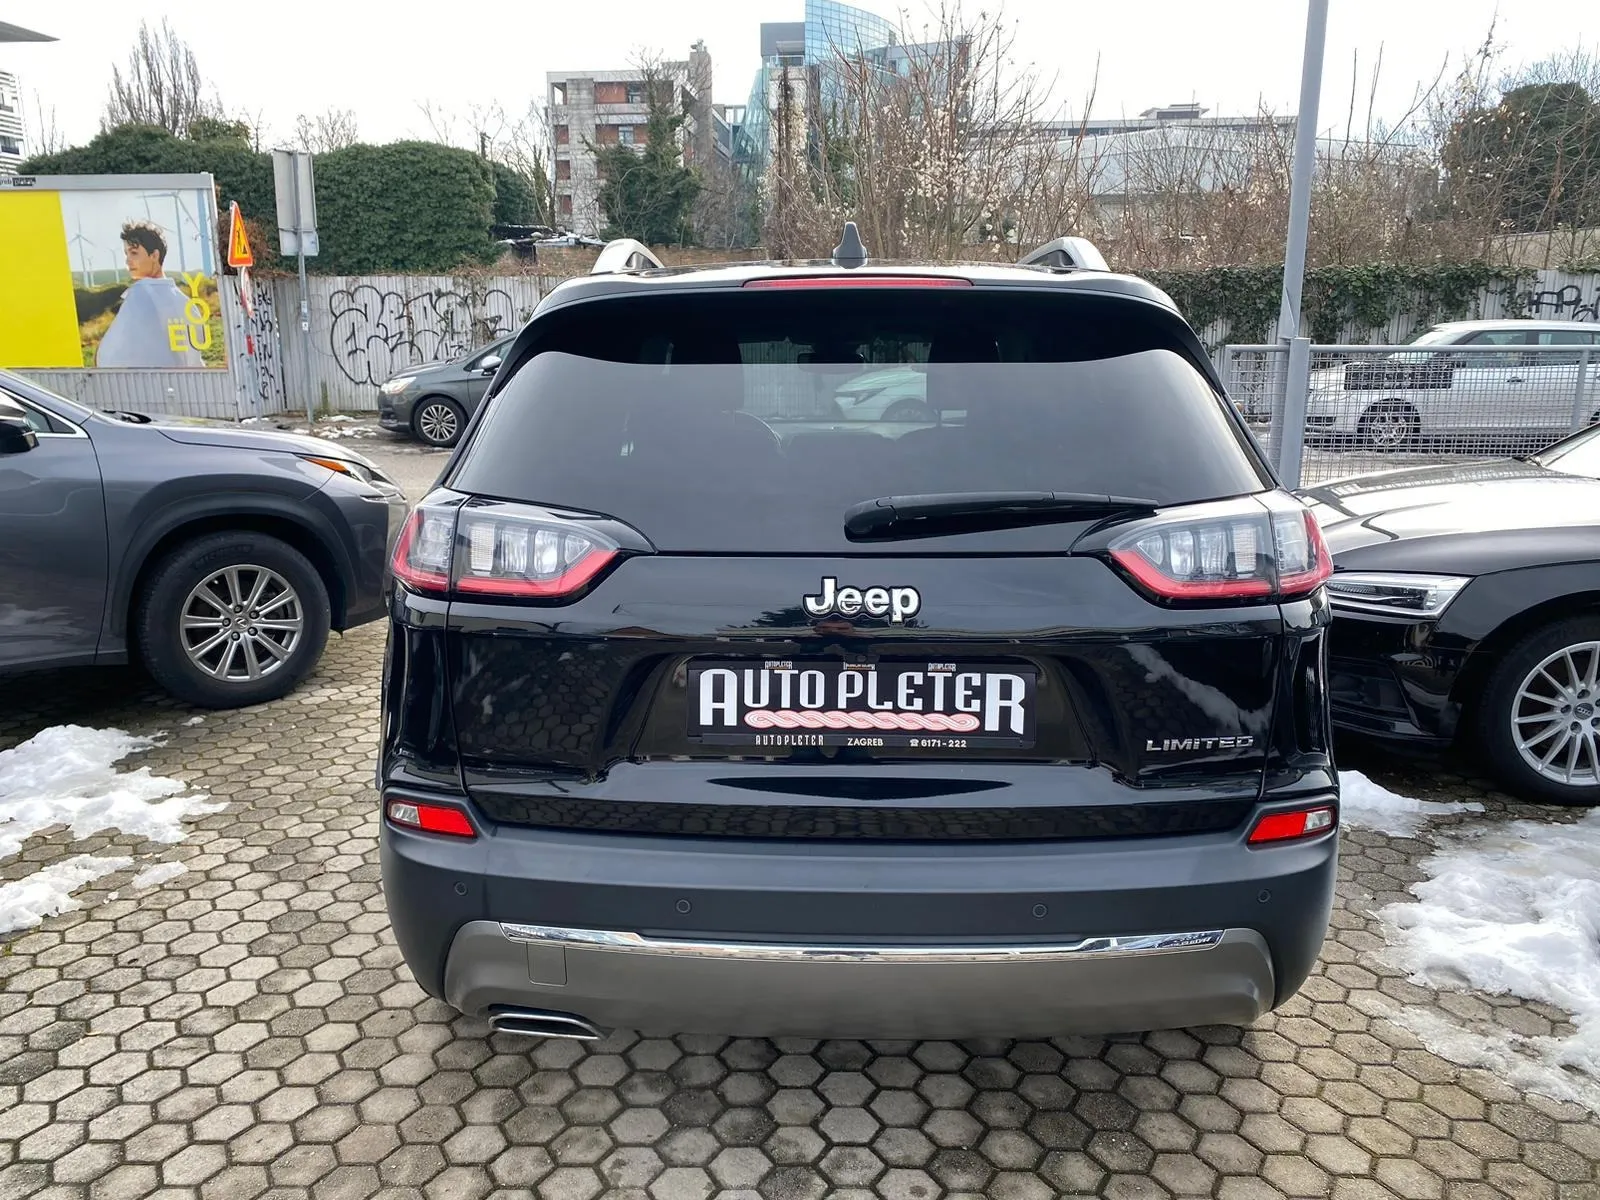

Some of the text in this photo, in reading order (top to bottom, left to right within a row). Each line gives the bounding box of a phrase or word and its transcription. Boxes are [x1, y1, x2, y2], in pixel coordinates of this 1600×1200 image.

[804, 577, 920, 623] Jeep
[755, 734, 825, 746] AUTOPLETER
[847, 737, 884, 747] ZAGREB
[1146, 735, 1254, 751] LIMITED
